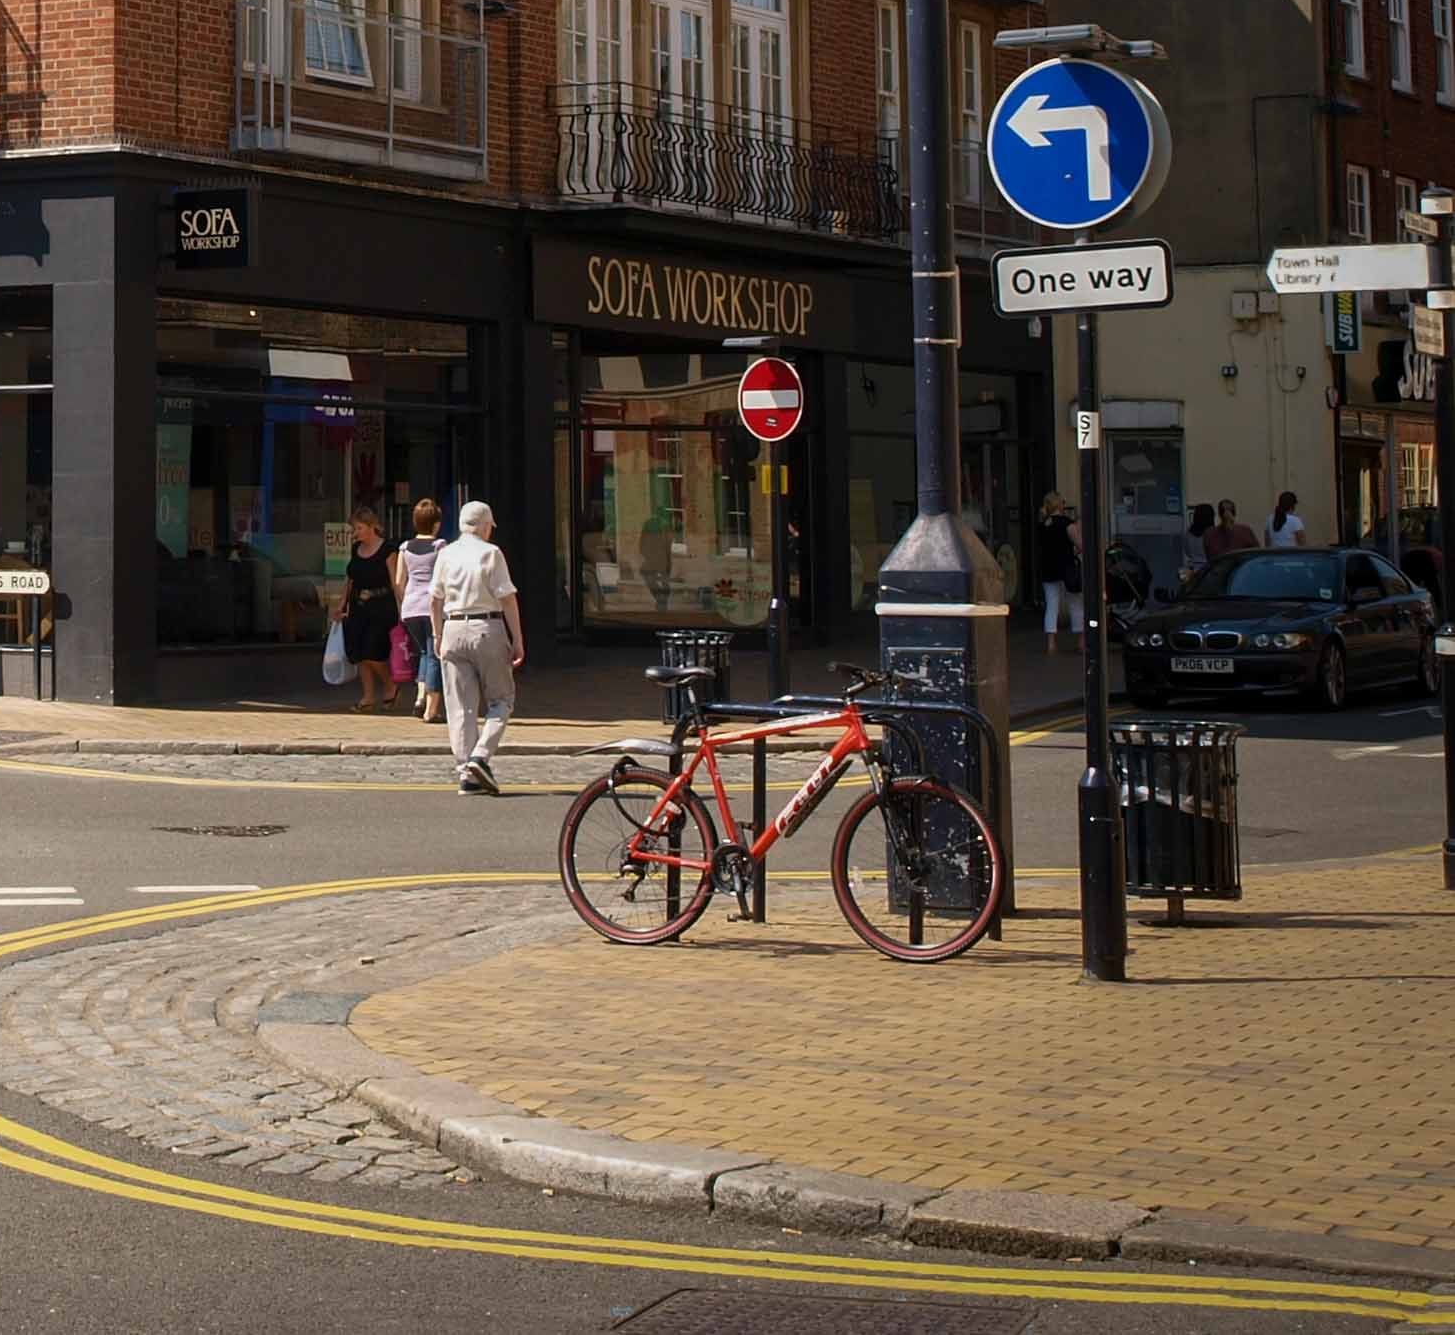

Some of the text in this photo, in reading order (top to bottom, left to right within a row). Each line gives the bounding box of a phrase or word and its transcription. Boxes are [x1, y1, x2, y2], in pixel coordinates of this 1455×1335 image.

[180, 208, 240, 237] SOFA
[180, 235, 240, 250] WORKSHOP
[1275, 254, 1339, 269] Town Hall
[1011, 266, 1152, 294] One way
[1275, 272, 1321, 285] Library
[587, 255, 813, 335] SOFA WORKSHOP
[1081, 415, 1090, 429] S
[1081, 431, 1089, 445] 7
[326, 527, 353, 547] extr
[11, 576, 44, 589] ROAD
